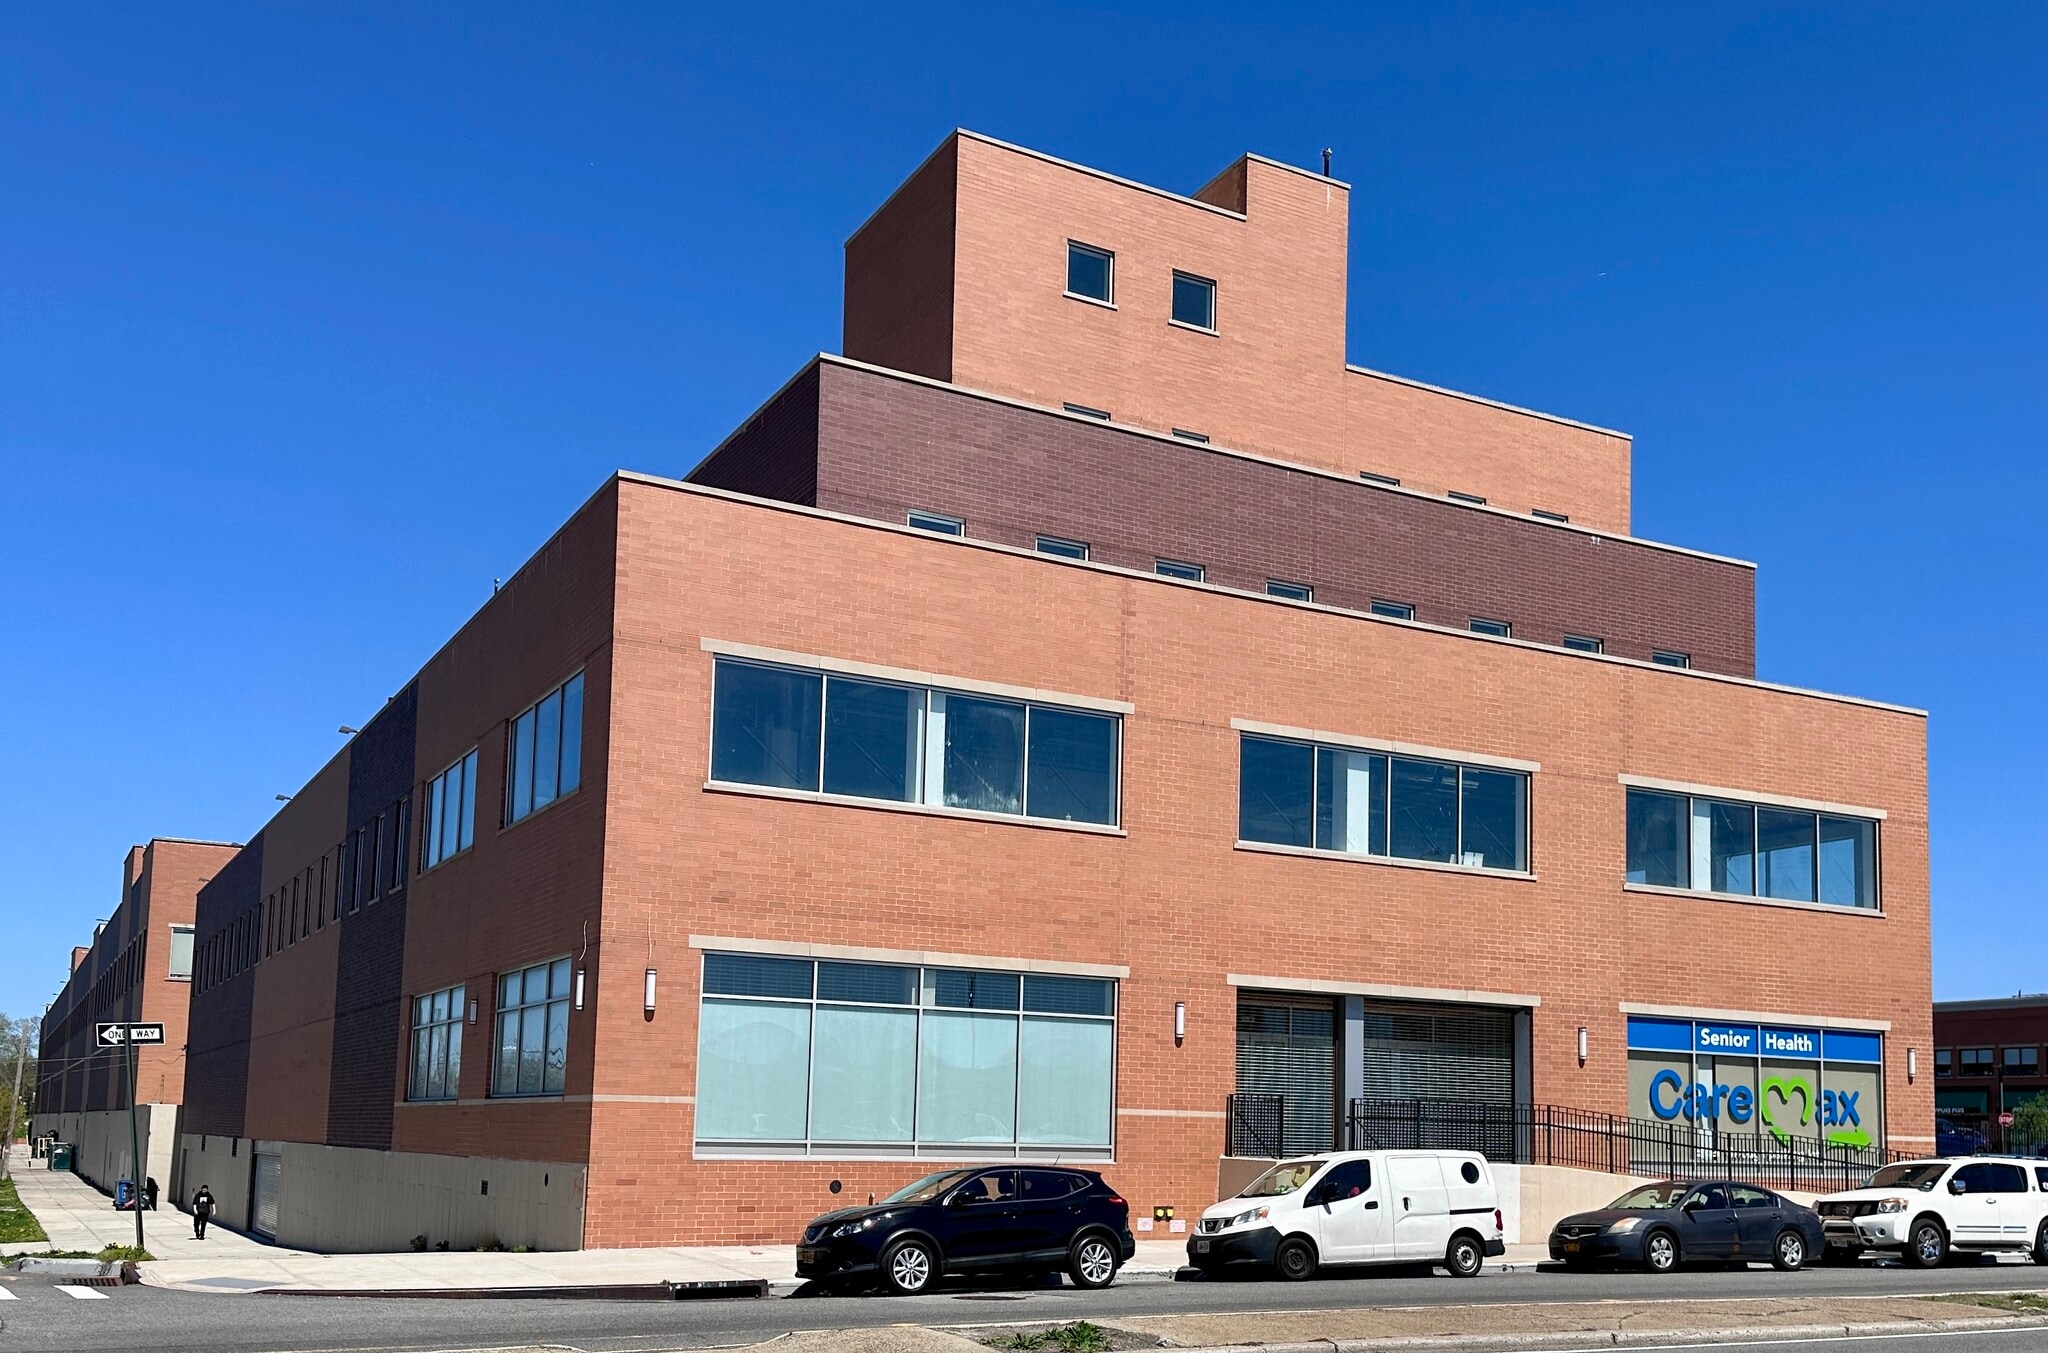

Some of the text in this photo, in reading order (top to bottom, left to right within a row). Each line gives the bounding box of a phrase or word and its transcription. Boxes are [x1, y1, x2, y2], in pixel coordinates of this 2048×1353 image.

[136, 1030, 156, 1038] WAY
[1700, 1028, 1813, 1052] Senior Health
